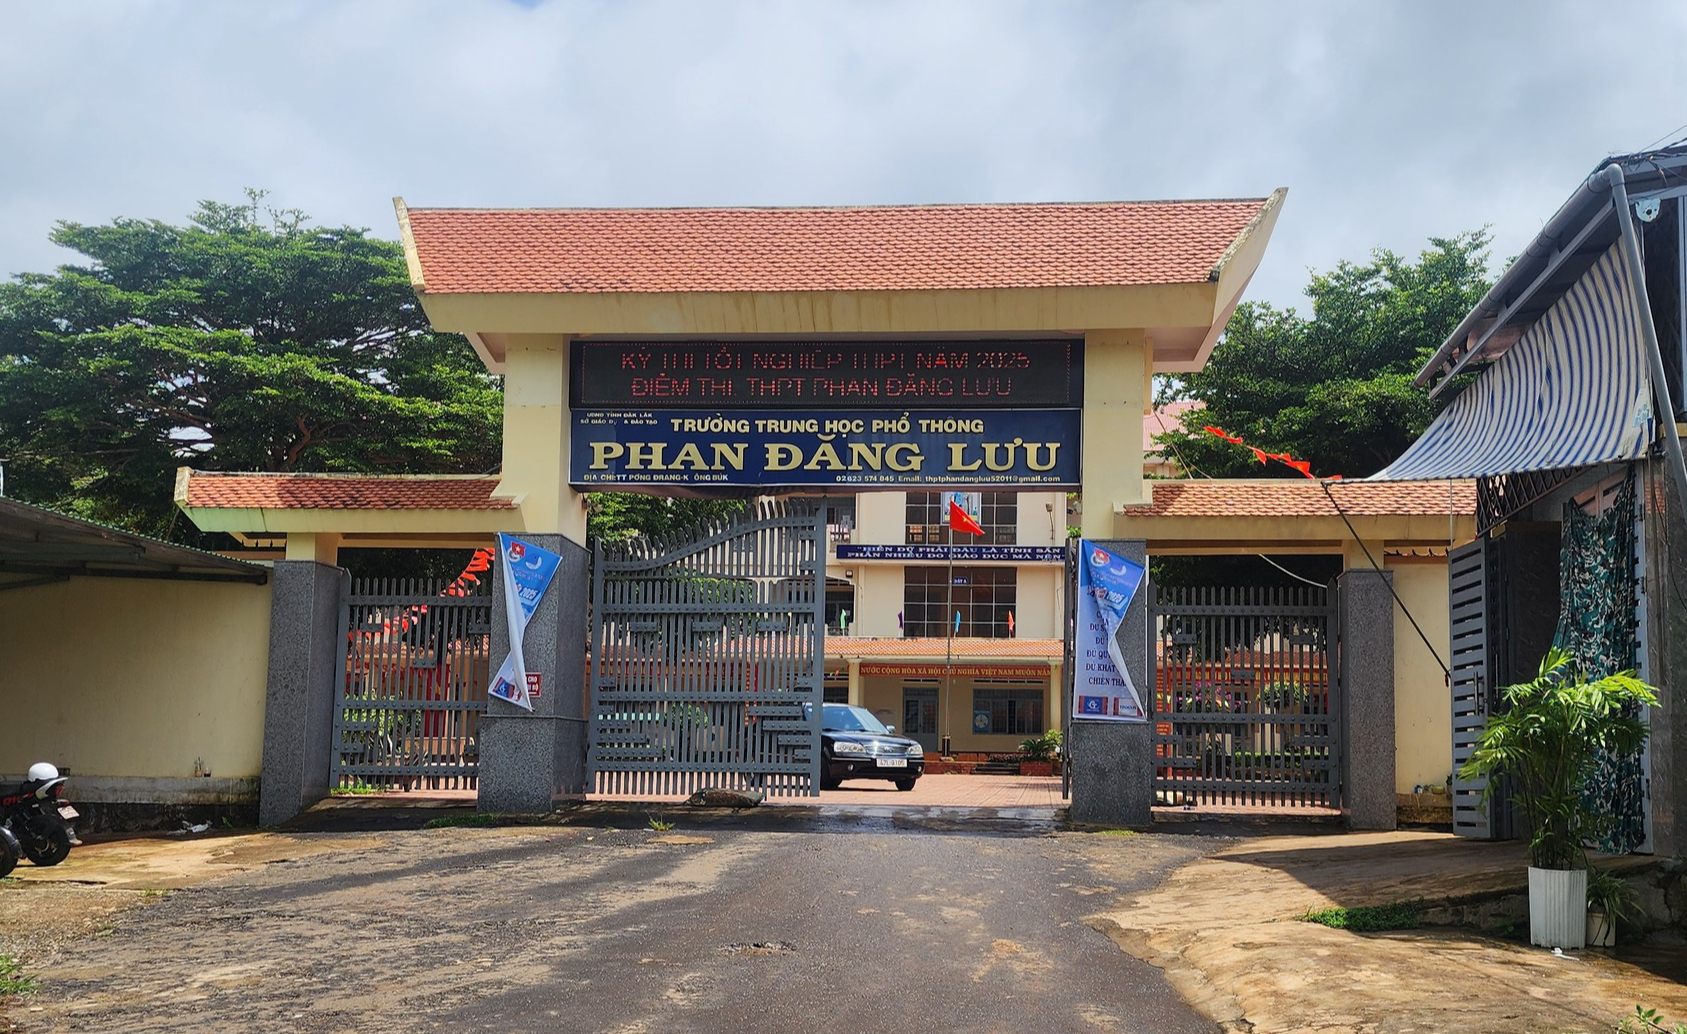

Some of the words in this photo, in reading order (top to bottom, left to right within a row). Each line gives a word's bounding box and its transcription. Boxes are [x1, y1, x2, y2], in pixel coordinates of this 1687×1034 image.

[976, 352, 1030, 369] 2025
[746, 378, 806, 396] THPT
[813, 377, 878, 396] PHAN
[886, 372, 954, 396] ĐĂNG
[671, 413, 750, 432] TRƯỜNG
[755, 419, 818, 433] TRUNG
[825, 419, 864, 438] HỌC
[872, 412, 910, 433] PHỔ
[918, 416, 984, 433] THÔNG
[589, 442, 748, 470] PHAN
[764, 434, 925, 471] ĐĂNG
[947, 437, 1060, 471] LƯU
